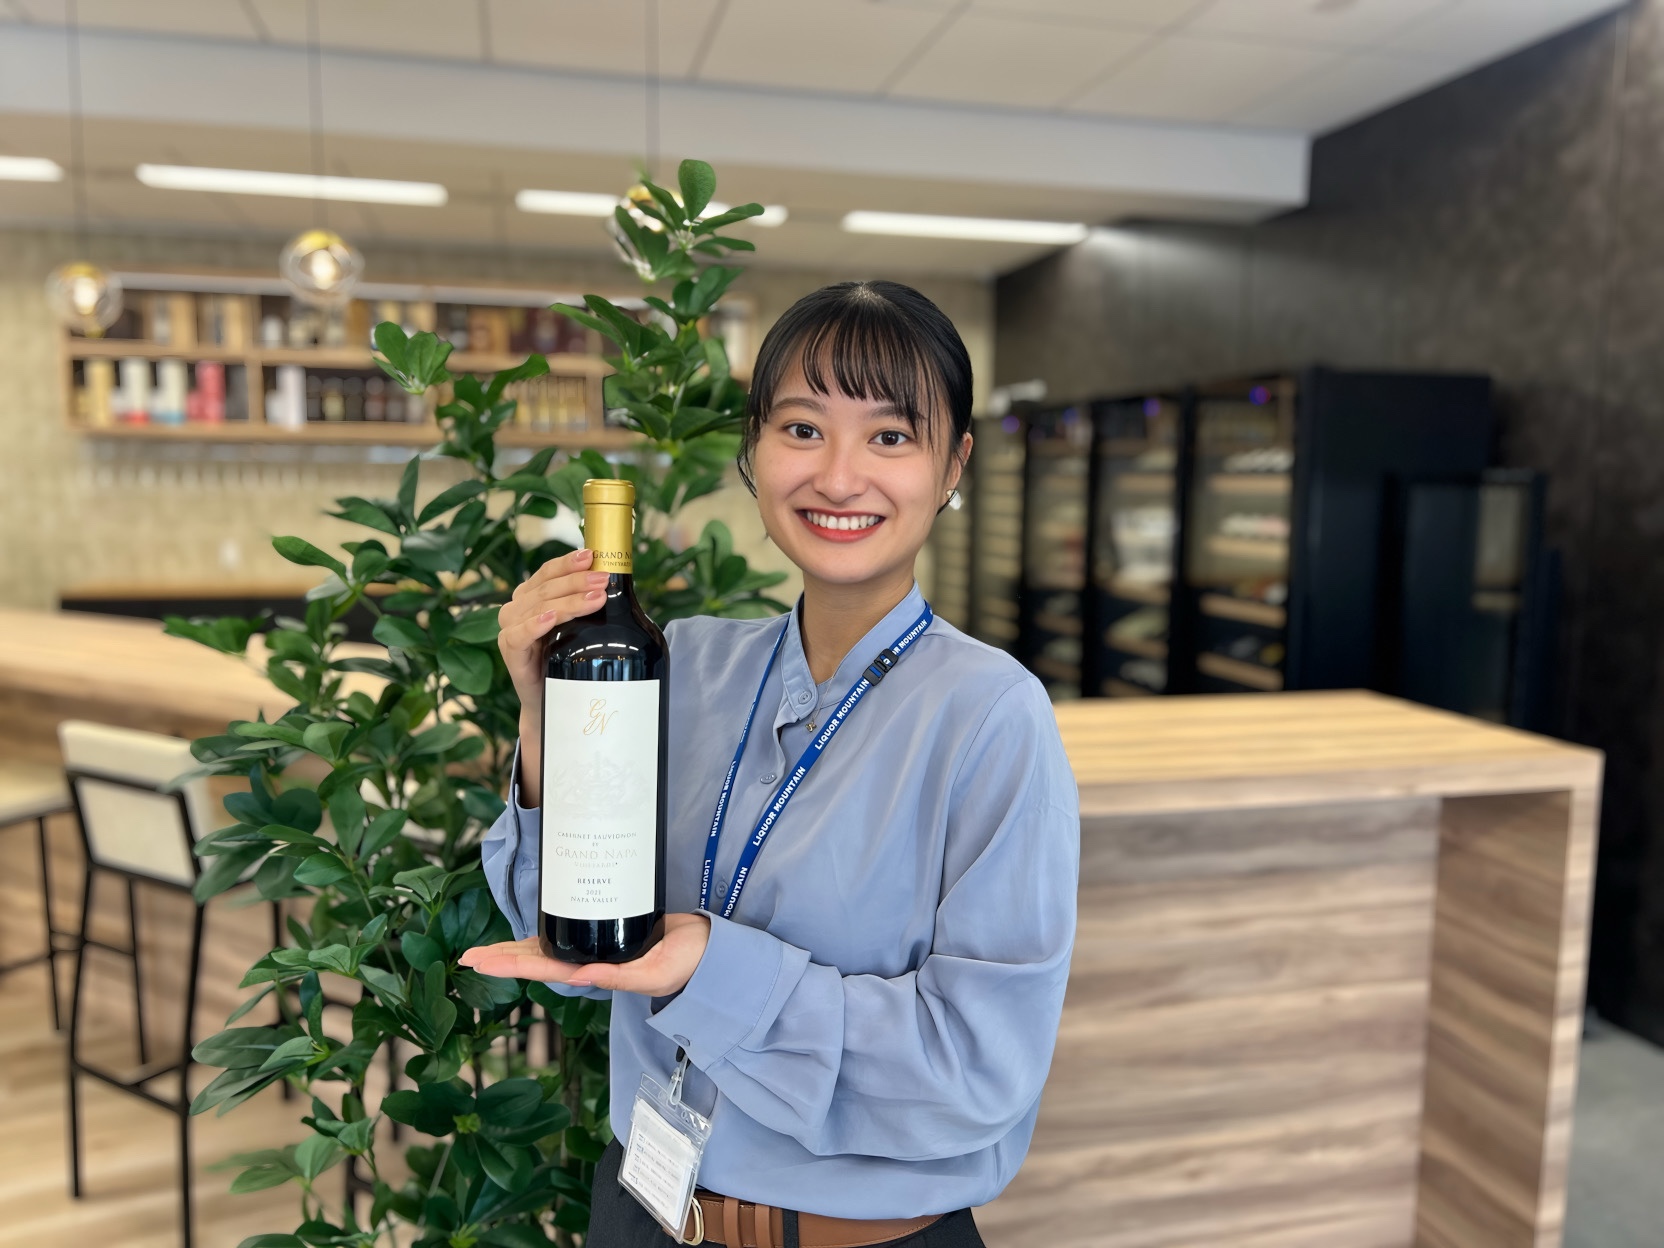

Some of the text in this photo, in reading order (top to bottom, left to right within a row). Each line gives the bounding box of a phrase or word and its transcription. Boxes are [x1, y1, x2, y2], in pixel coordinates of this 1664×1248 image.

[592, 550, 623, 559] GRAND
[898, 619, 928, 650] MOUNTAIN
[814, 678, 870, 750] LIQUOR MOUNTAIN
[710, 790, 727, 837] MOUNTAIN
[752, 765, 806, 847] LIQUOR MOUNTAIN
[555, 846, 637, 860] GRAND NAPA
[593, 831, 637, 840] SAUVIGNON
[701, 859, 712, 895] LIQUOR
[724, 866, 748, 917] MOUNTAIN
